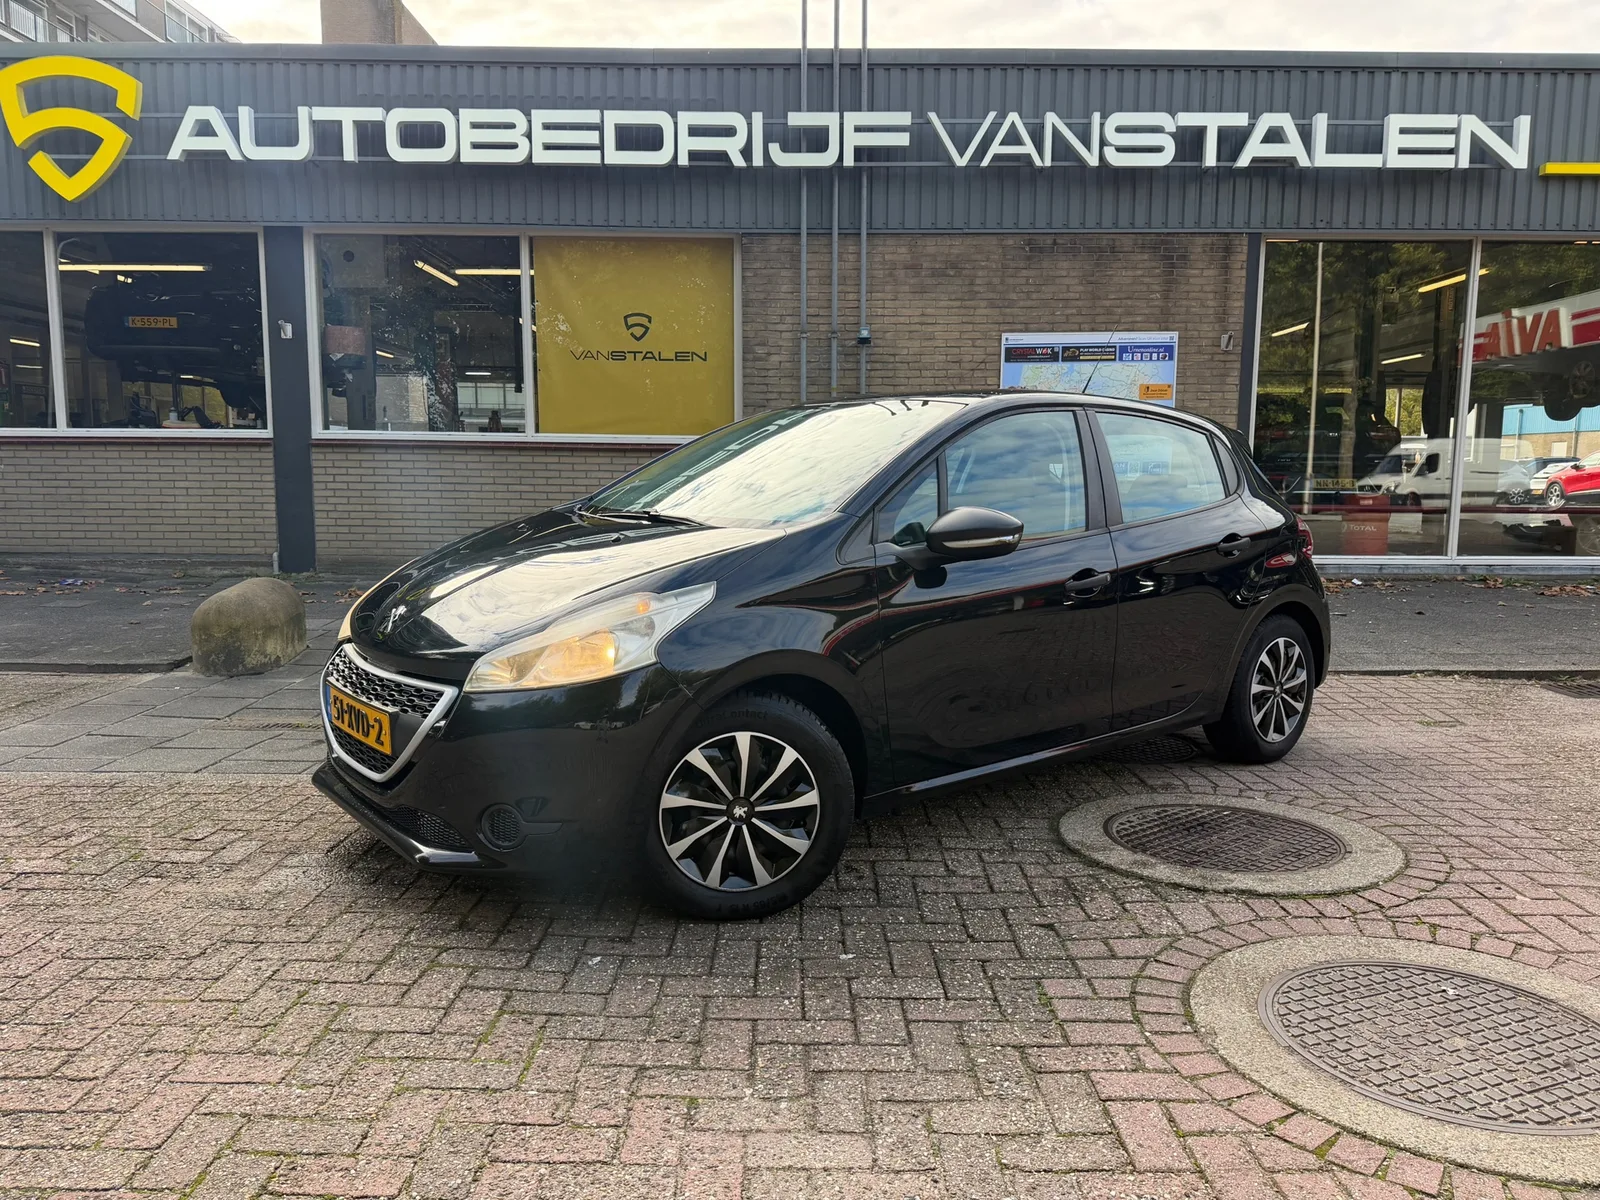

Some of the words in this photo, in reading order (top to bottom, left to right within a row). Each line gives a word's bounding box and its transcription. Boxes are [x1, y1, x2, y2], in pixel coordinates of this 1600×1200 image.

[166, 105, 912, 168] AUTOBEDRIJF
[927, 110, 1532, 170] VANSTALEN
[131, 317, 174, 327] K-559-PL
[570, 350, 708, 362] VANSTALEN
